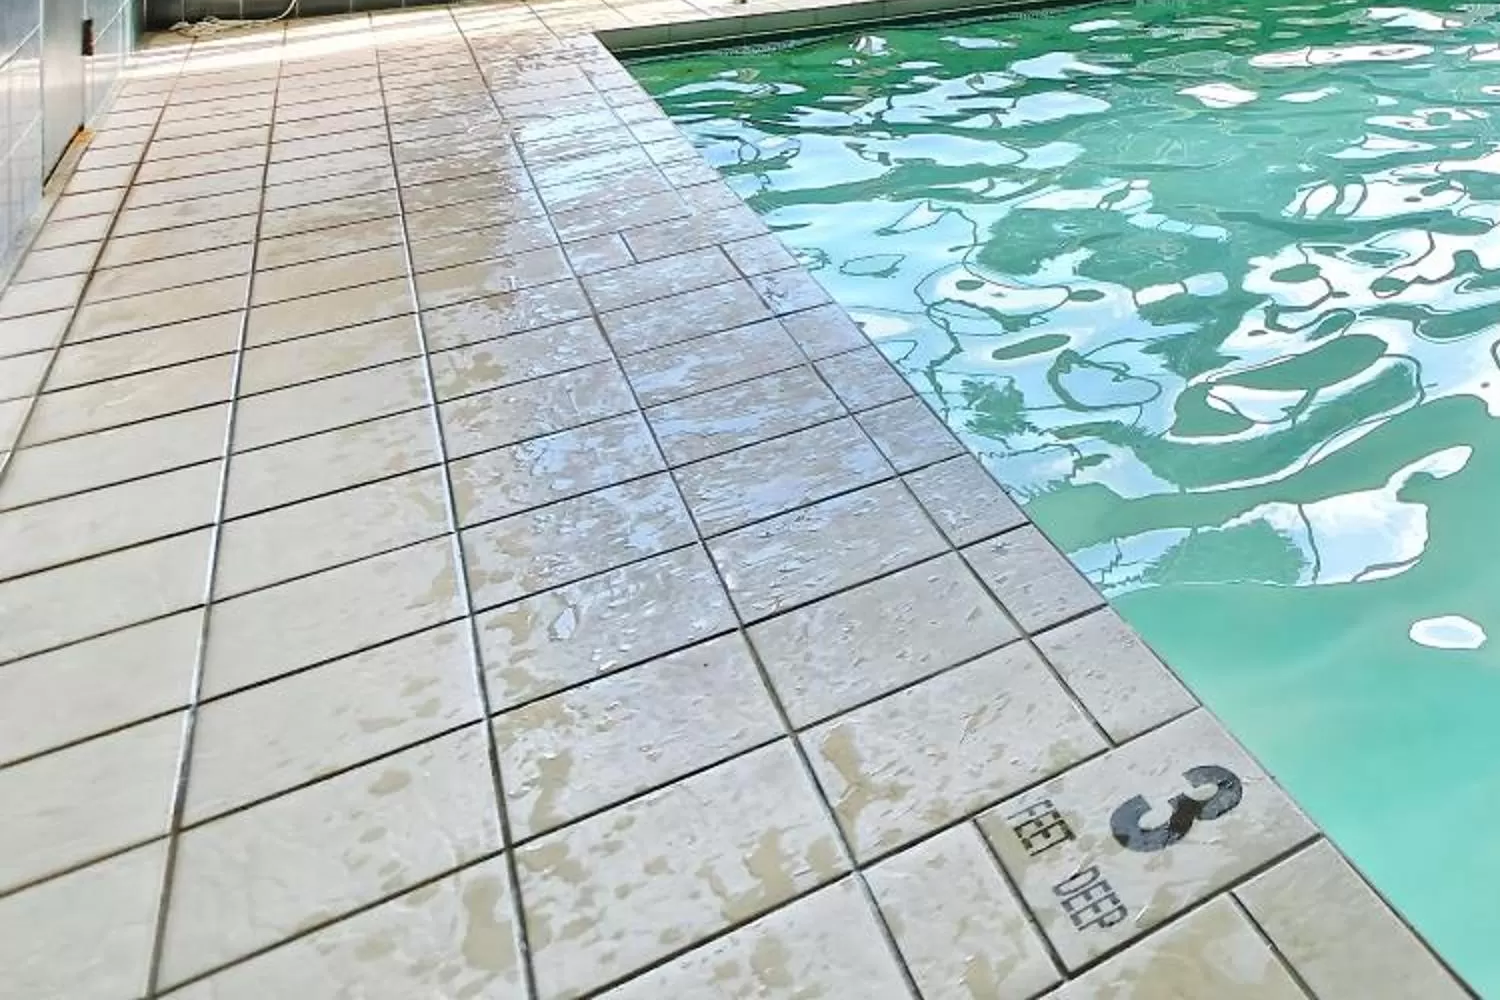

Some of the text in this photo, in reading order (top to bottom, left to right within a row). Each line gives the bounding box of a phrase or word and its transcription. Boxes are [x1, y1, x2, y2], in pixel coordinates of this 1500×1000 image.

[1110, 765, 1243, 852] 3
[1007, 799, 1128, 932] FEET DEEP
